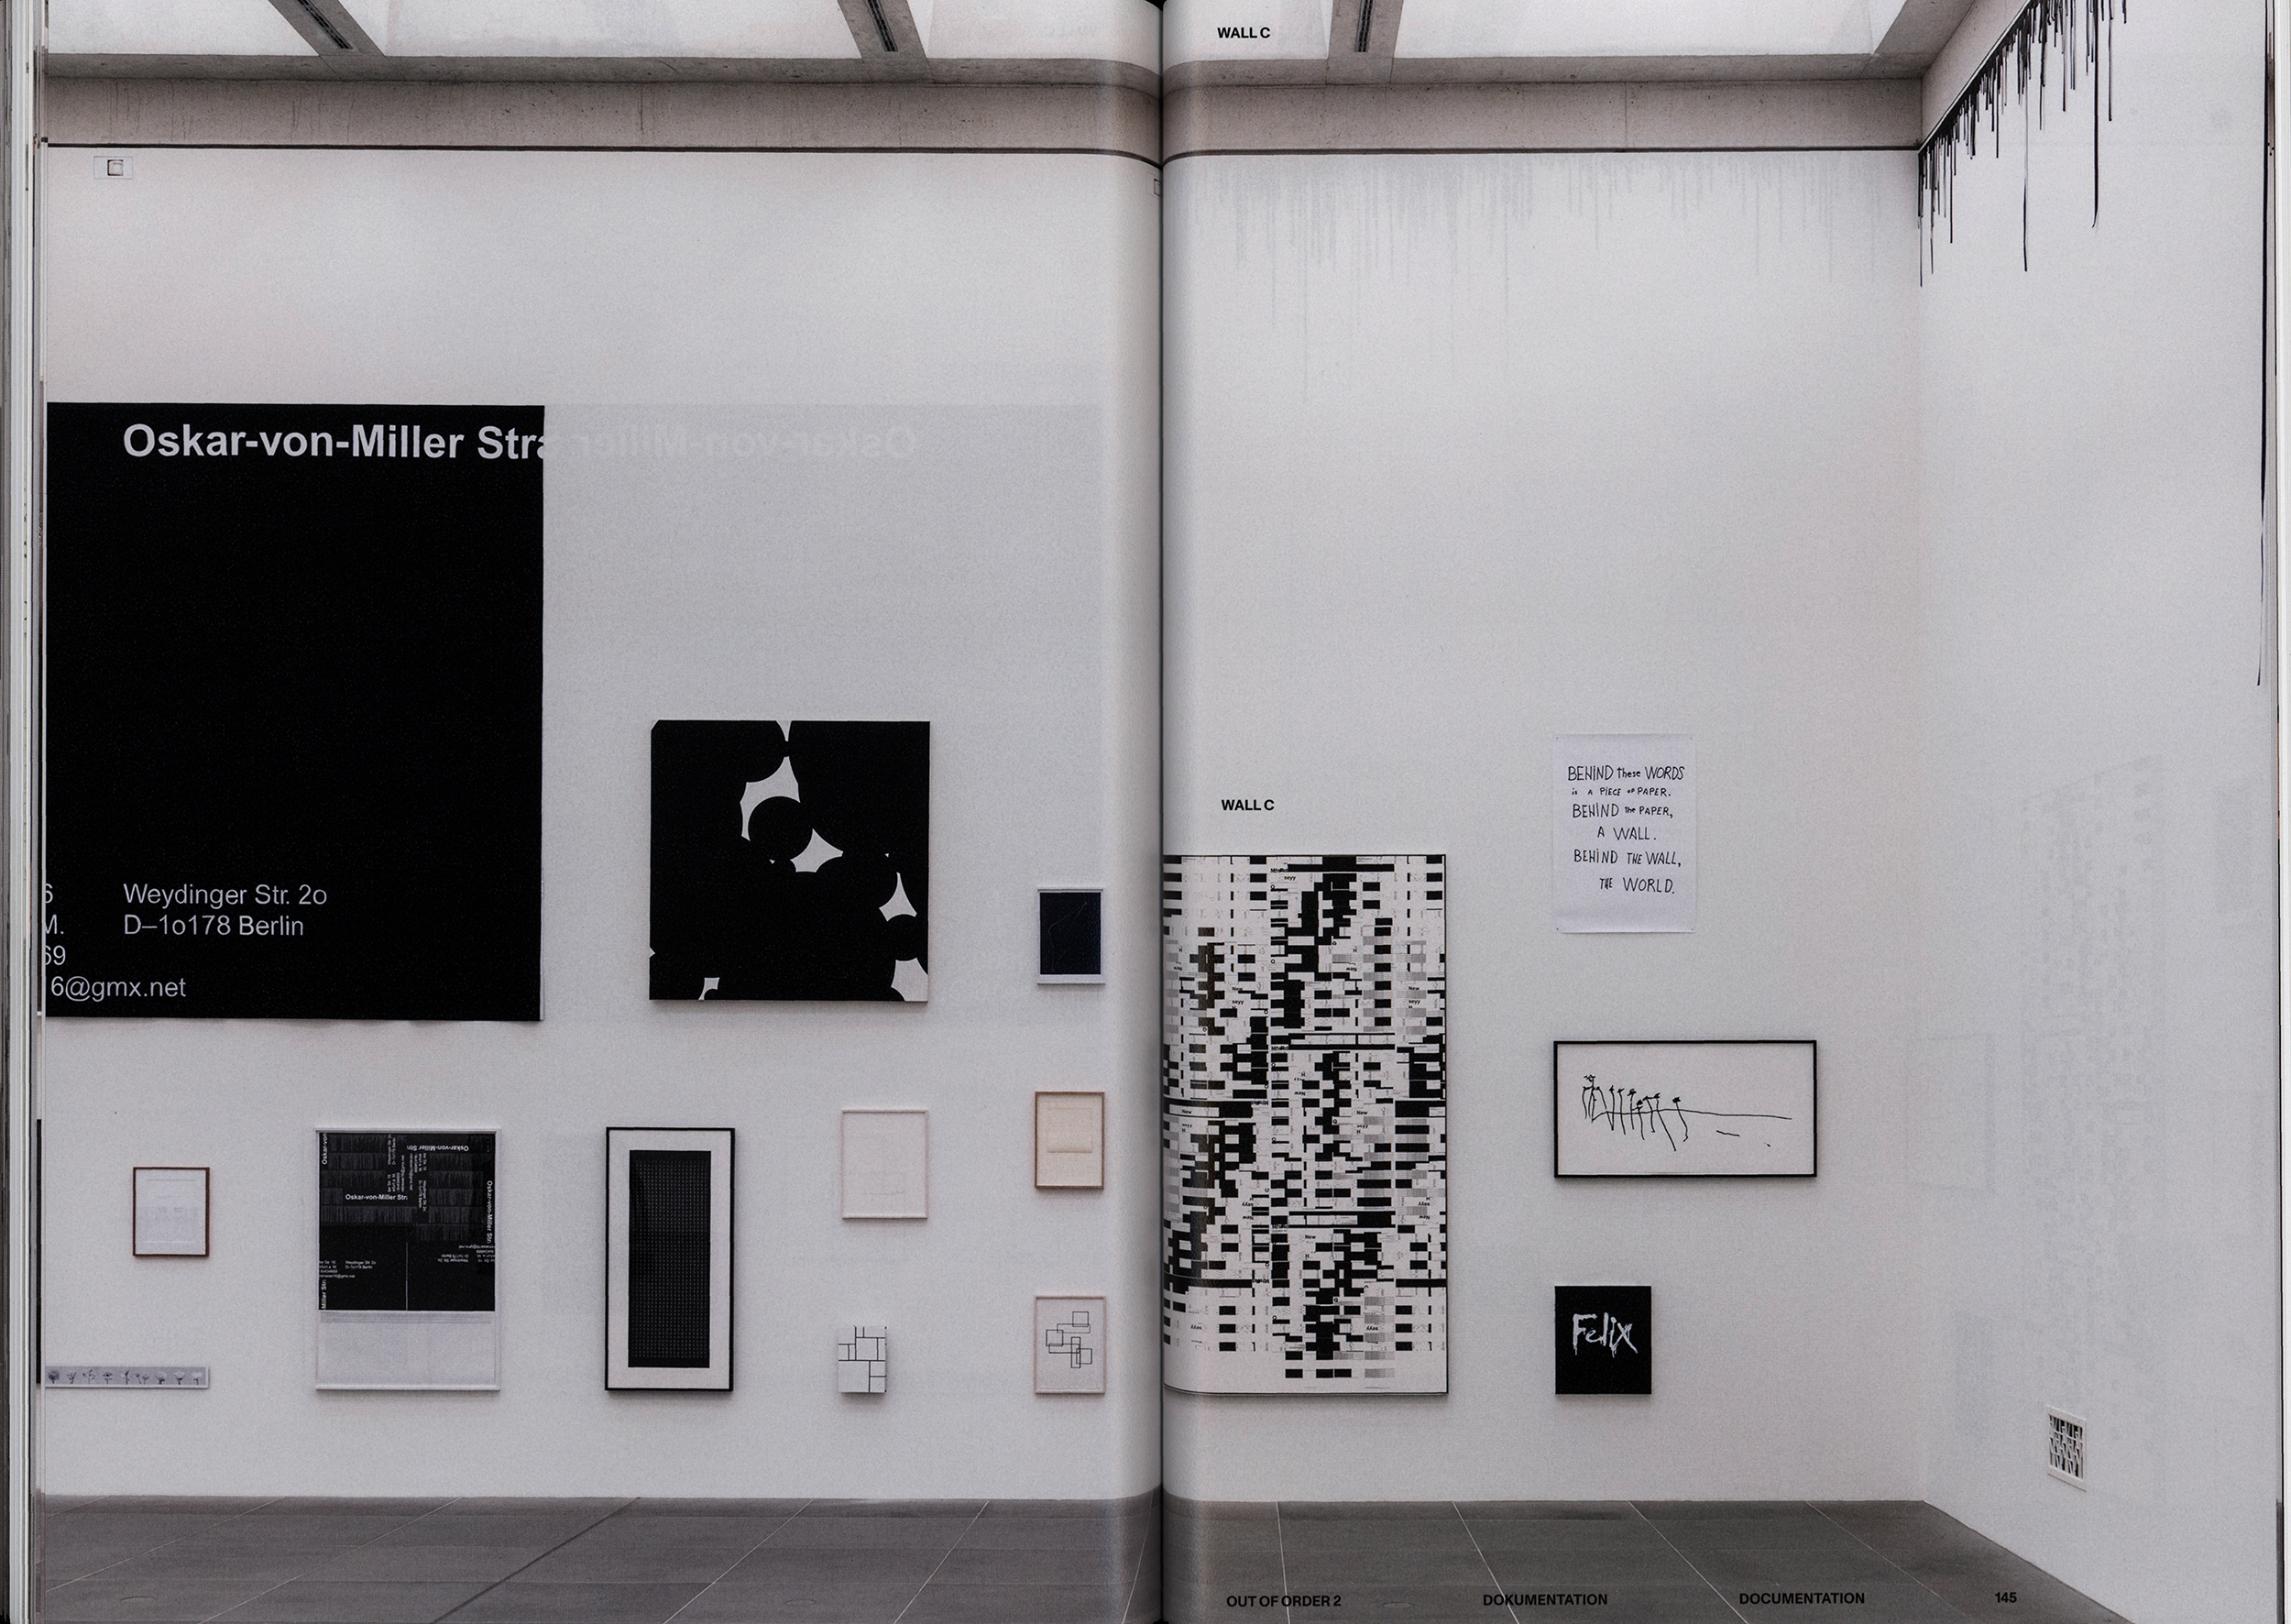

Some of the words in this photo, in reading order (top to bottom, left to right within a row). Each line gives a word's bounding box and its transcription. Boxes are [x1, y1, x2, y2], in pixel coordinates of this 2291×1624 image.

[123, 423, 465, 458] Oskar-von-Miller
[1644, 765, 1685, 781] WORDS
[1637, 786, 1672, 797] PAPER.
[1639, 806, 1673, 819] PAPER,
[1596, 826, 1606, 839] A
[1612, 826, 1657, 841] WALL.
[1627, 851, 1643, 865] THE
[1645, 850, 1682, 868] WALL,
[1599, 877, 1613, 890] THE
[1622, 877, 1675, 894] WORLD.
[123, 883, 247, 910] Weydinger
[255, 883, 290, 905] Str.
[239, 915, 303, 936] Berlin
[50, 975, 187, 1003] 6@gmx.net
[1572, 1311, 1639, 1358] Felix
